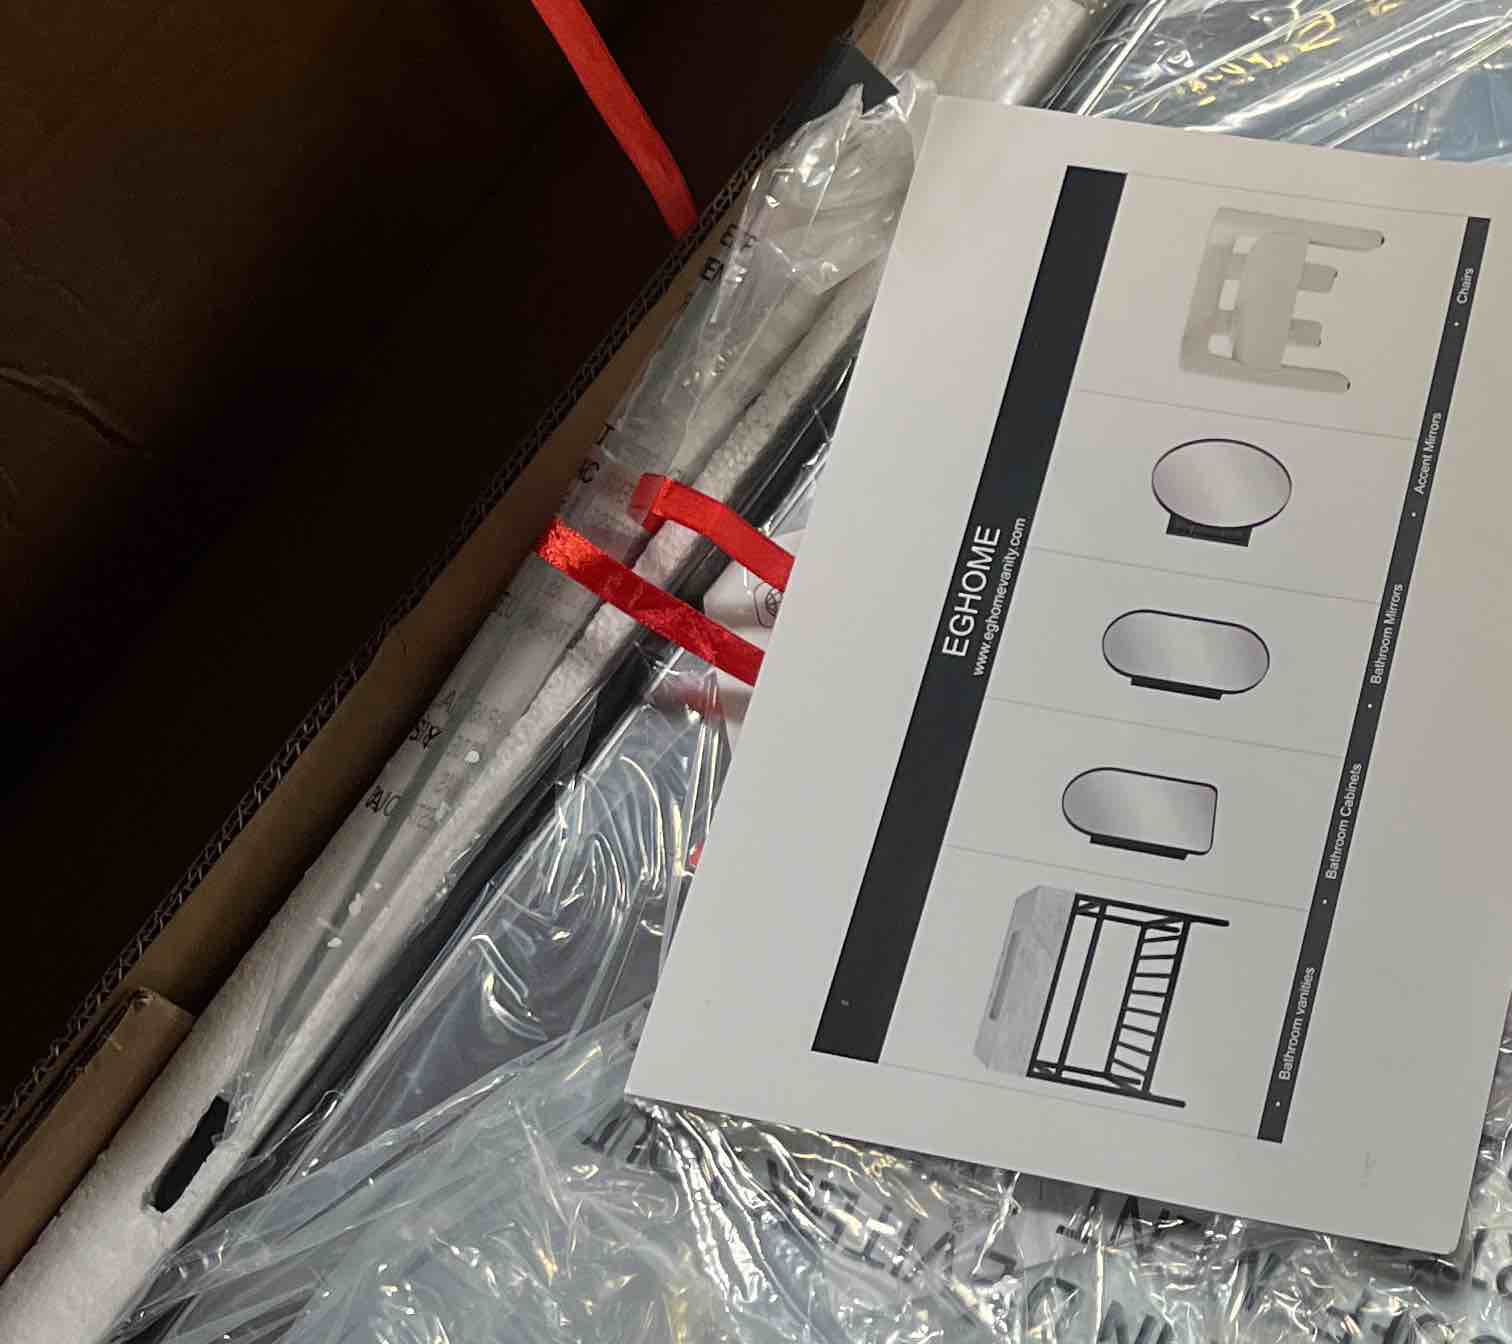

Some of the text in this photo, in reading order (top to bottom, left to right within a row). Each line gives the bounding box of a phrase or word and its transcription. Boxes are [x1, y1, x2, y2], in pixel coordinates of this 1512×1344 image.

[1456, 267, 1475, 304] Chairs
[1413, 412, 1442, 494] Accent Mirrors
[942, 525, 1001, 657] EGHOME
[972, 517, 1027, 676] www.eghomevanity.com
[1370, 584, 1404, 684] Bathroom Mirrors
[1325, 762, 1362, 880] Bathroom Cabinets
[1278, 967, 1316, 1080] Bathroom vanities
